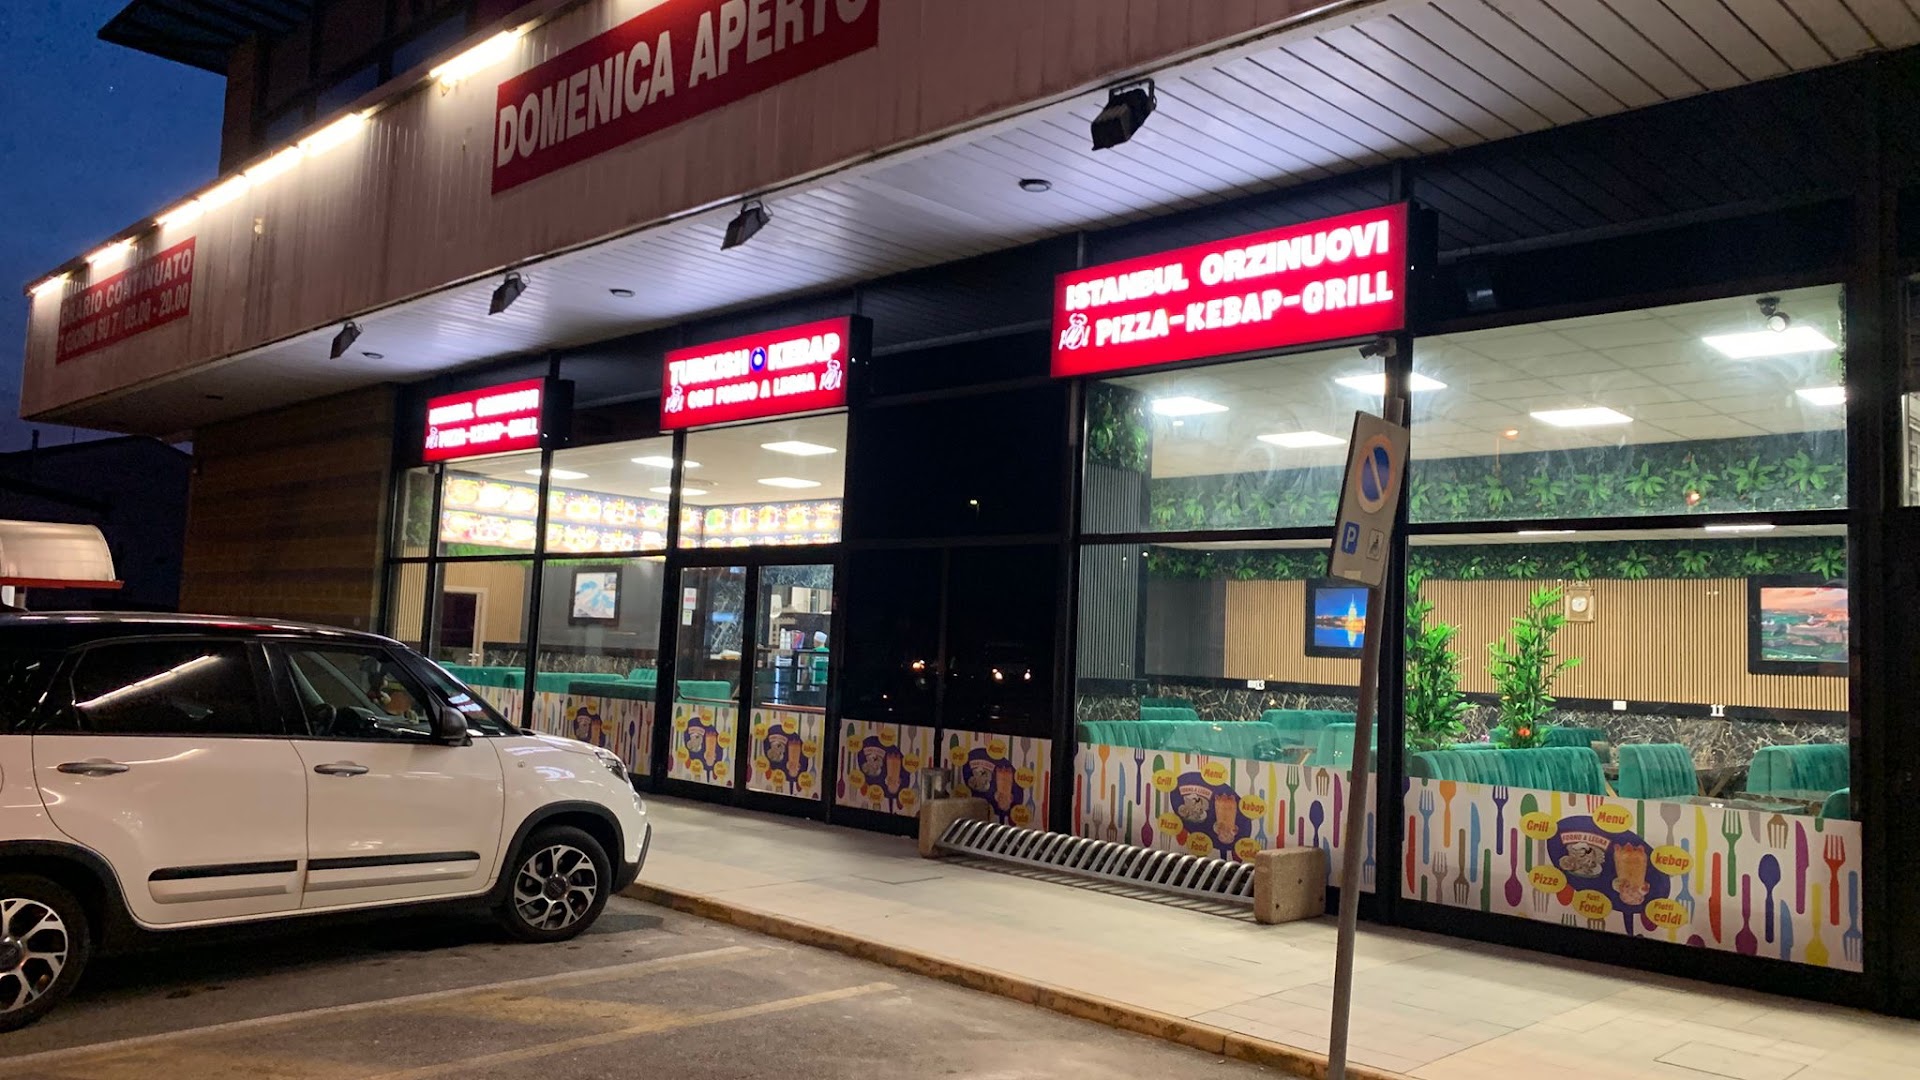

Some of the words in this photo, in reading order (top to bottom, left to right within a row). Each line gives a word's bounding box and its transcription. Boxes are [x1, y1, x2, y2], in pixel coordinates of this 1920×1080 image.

[497, 30, 675, 168] DOMENICA
[1065, 263, 1189, 311] ISTANBUL
[1200, 219, 1390, 286] ORZINUOVI
[768, 332, 840, 371] KEBAP
[1526, 820, 1549, 833] Grill
[1655, 852, 1689, 870] kebap
[1533, 873, 1560, 886] Pizze
[1579, 901, 1605, 914] Food
